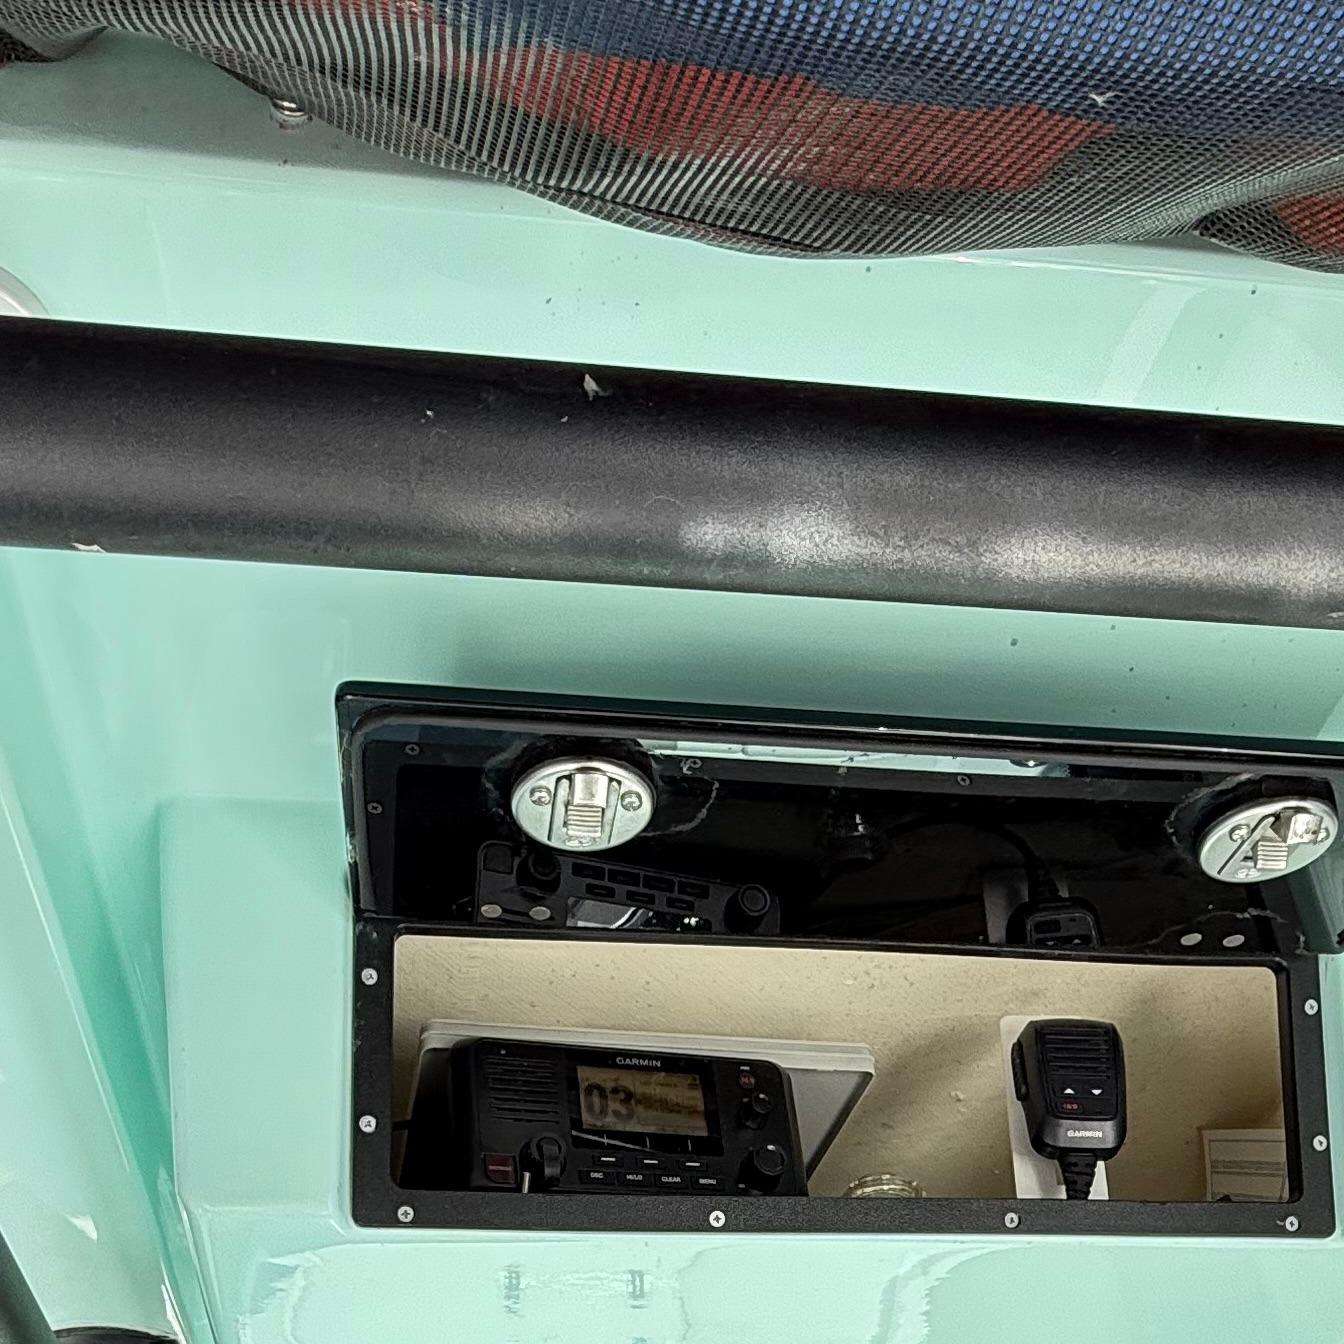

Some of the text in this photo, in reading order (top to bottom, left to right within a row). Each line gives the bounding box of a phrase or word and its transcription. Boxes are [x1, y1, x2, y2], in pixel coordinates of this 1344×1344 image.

[615, 1056, 662, 1068] GARMIN
[583, 1081, 635, 1121] 03
[1067, 1130, 1103, 1138] GARMIN
